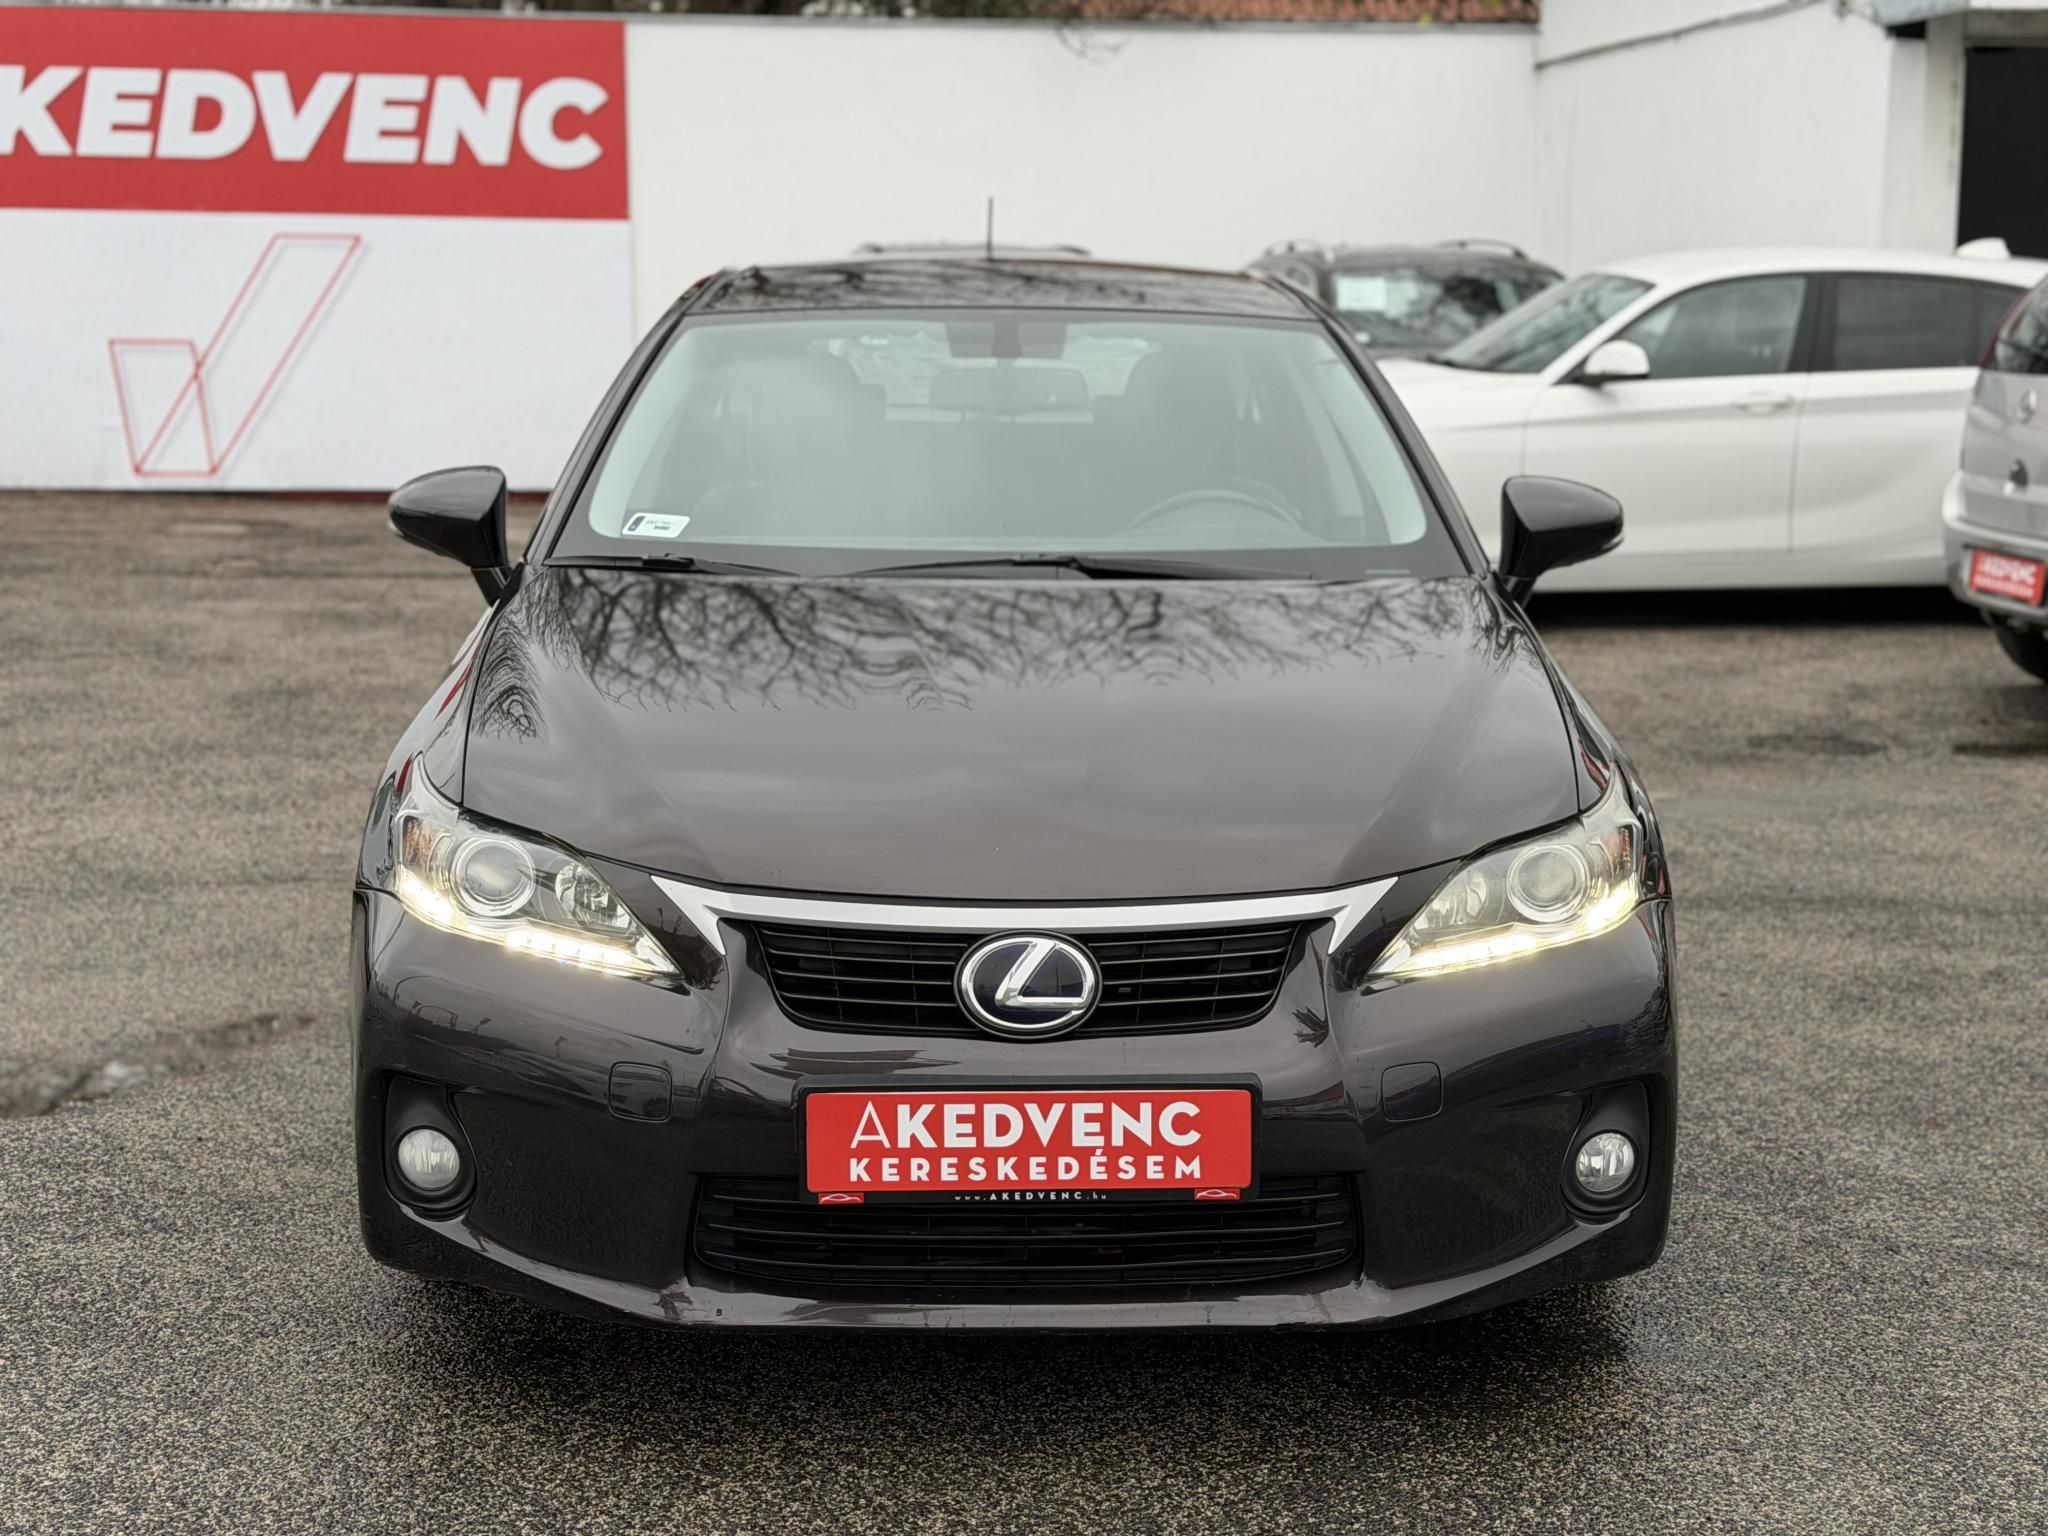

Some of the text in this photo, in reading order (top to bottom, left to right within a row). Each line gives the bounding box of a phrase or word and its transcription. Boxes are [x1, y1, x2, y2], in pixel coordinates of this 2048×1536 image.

[0, 64, 608, 171] KEDVENC
[849, 1100, 1202, 1149] AKEDVENC
[849, 1149, 1202, 1182] KERESKEDÉSEM
[954, 1191, 1107, 1201] www.AKEDVENC.hu
